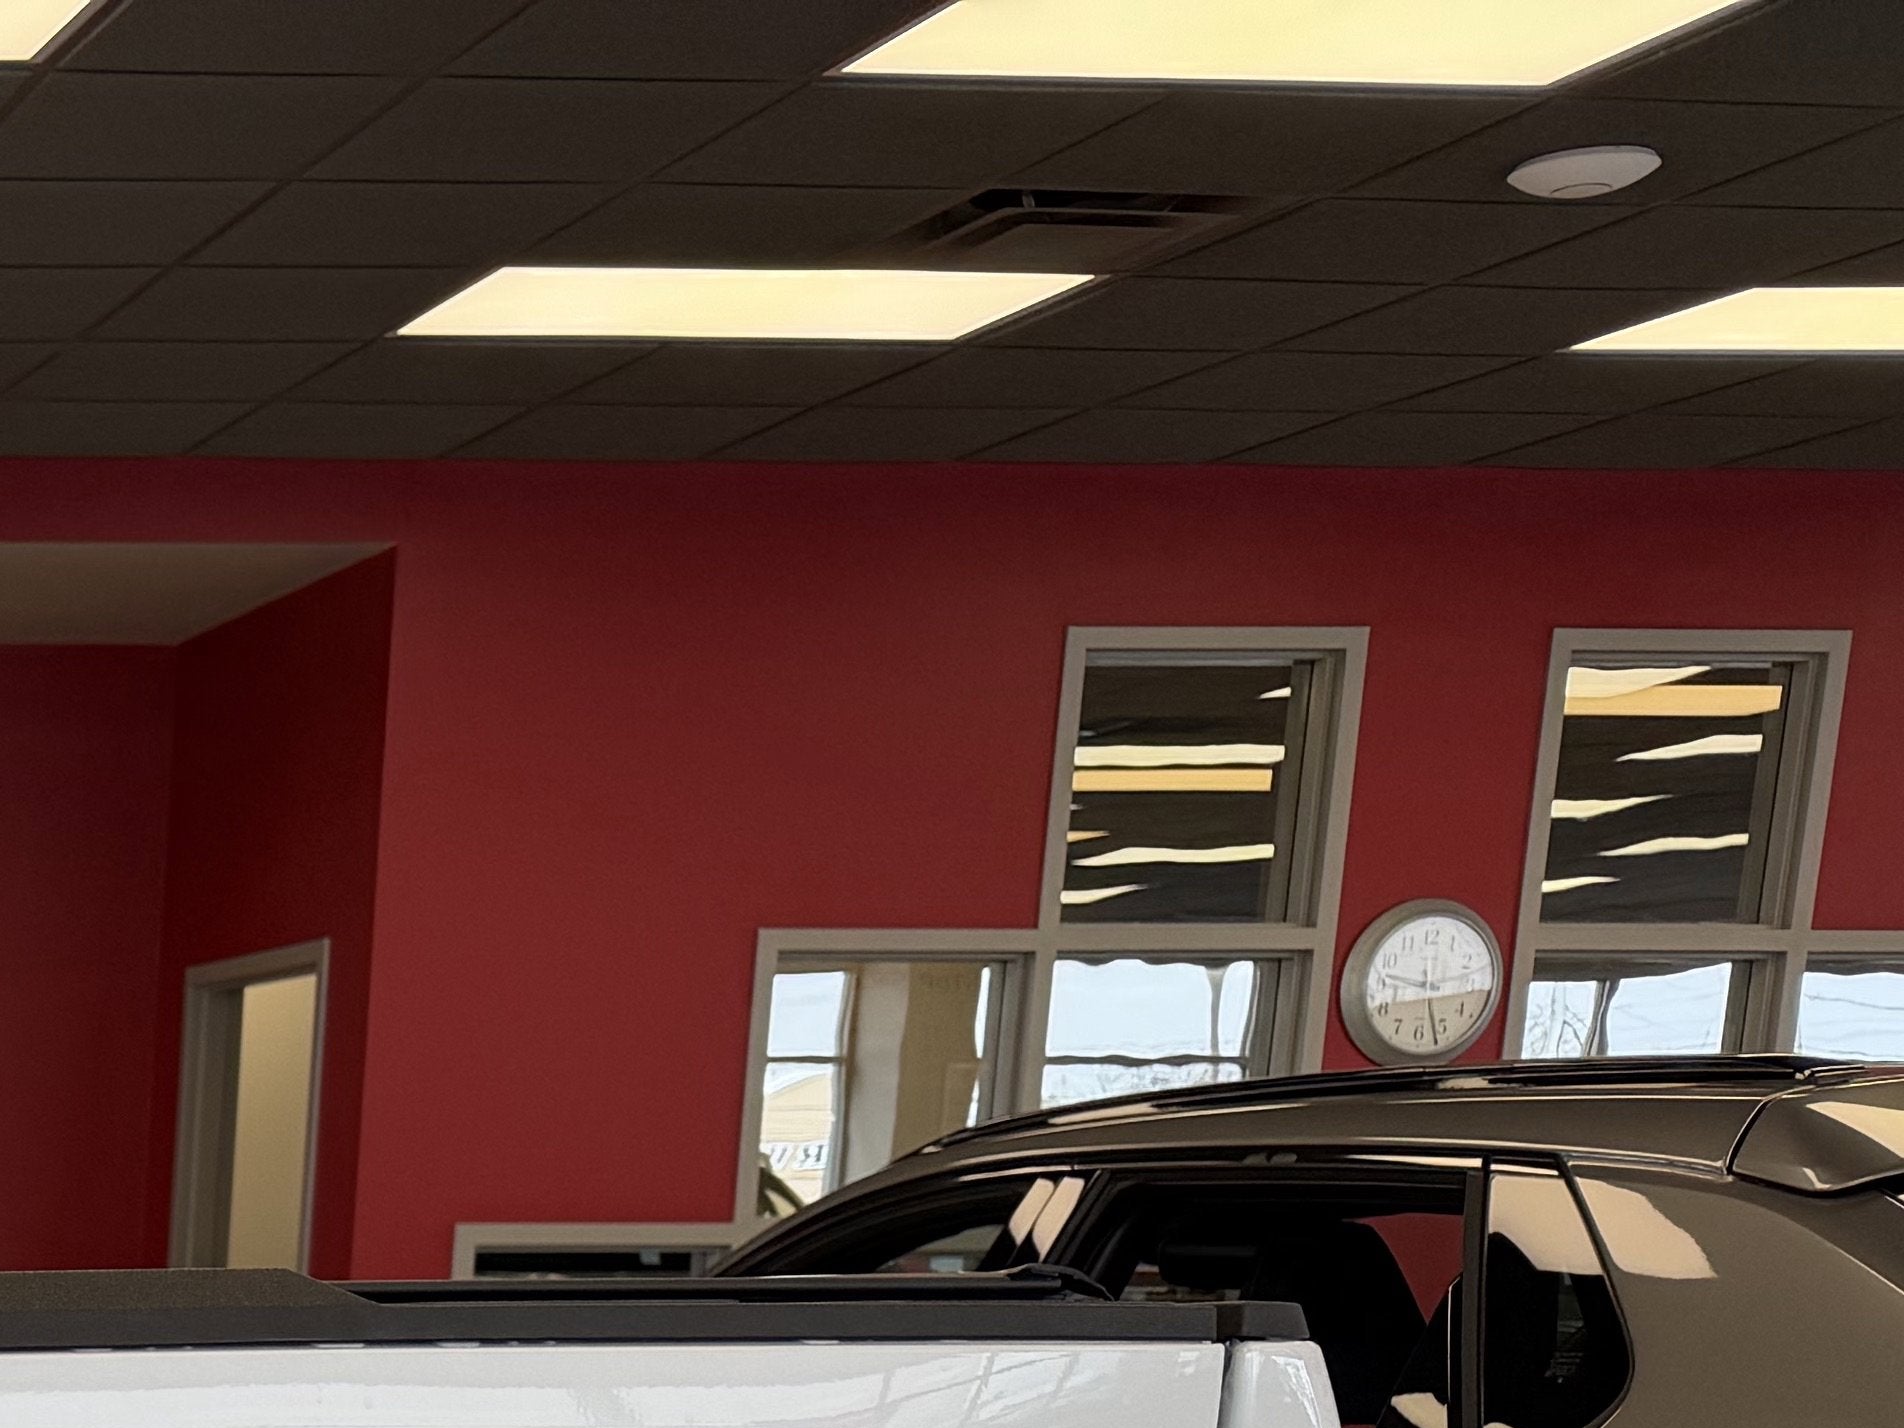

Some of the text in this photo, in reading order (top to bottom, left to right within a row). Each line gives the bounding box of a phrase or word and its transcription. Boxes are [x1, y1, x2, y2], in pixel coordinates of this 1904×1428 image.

[1402, 935, 1414, 951] 11
[1425, 930, 1440, 945] 12
[1382, 953, 1397, 969] 10
[1394, 1018, 1403, 1035] 7
[1414, 1025, 1424, 1041] 6
[1438, 1018, 1447, 1034] 5
